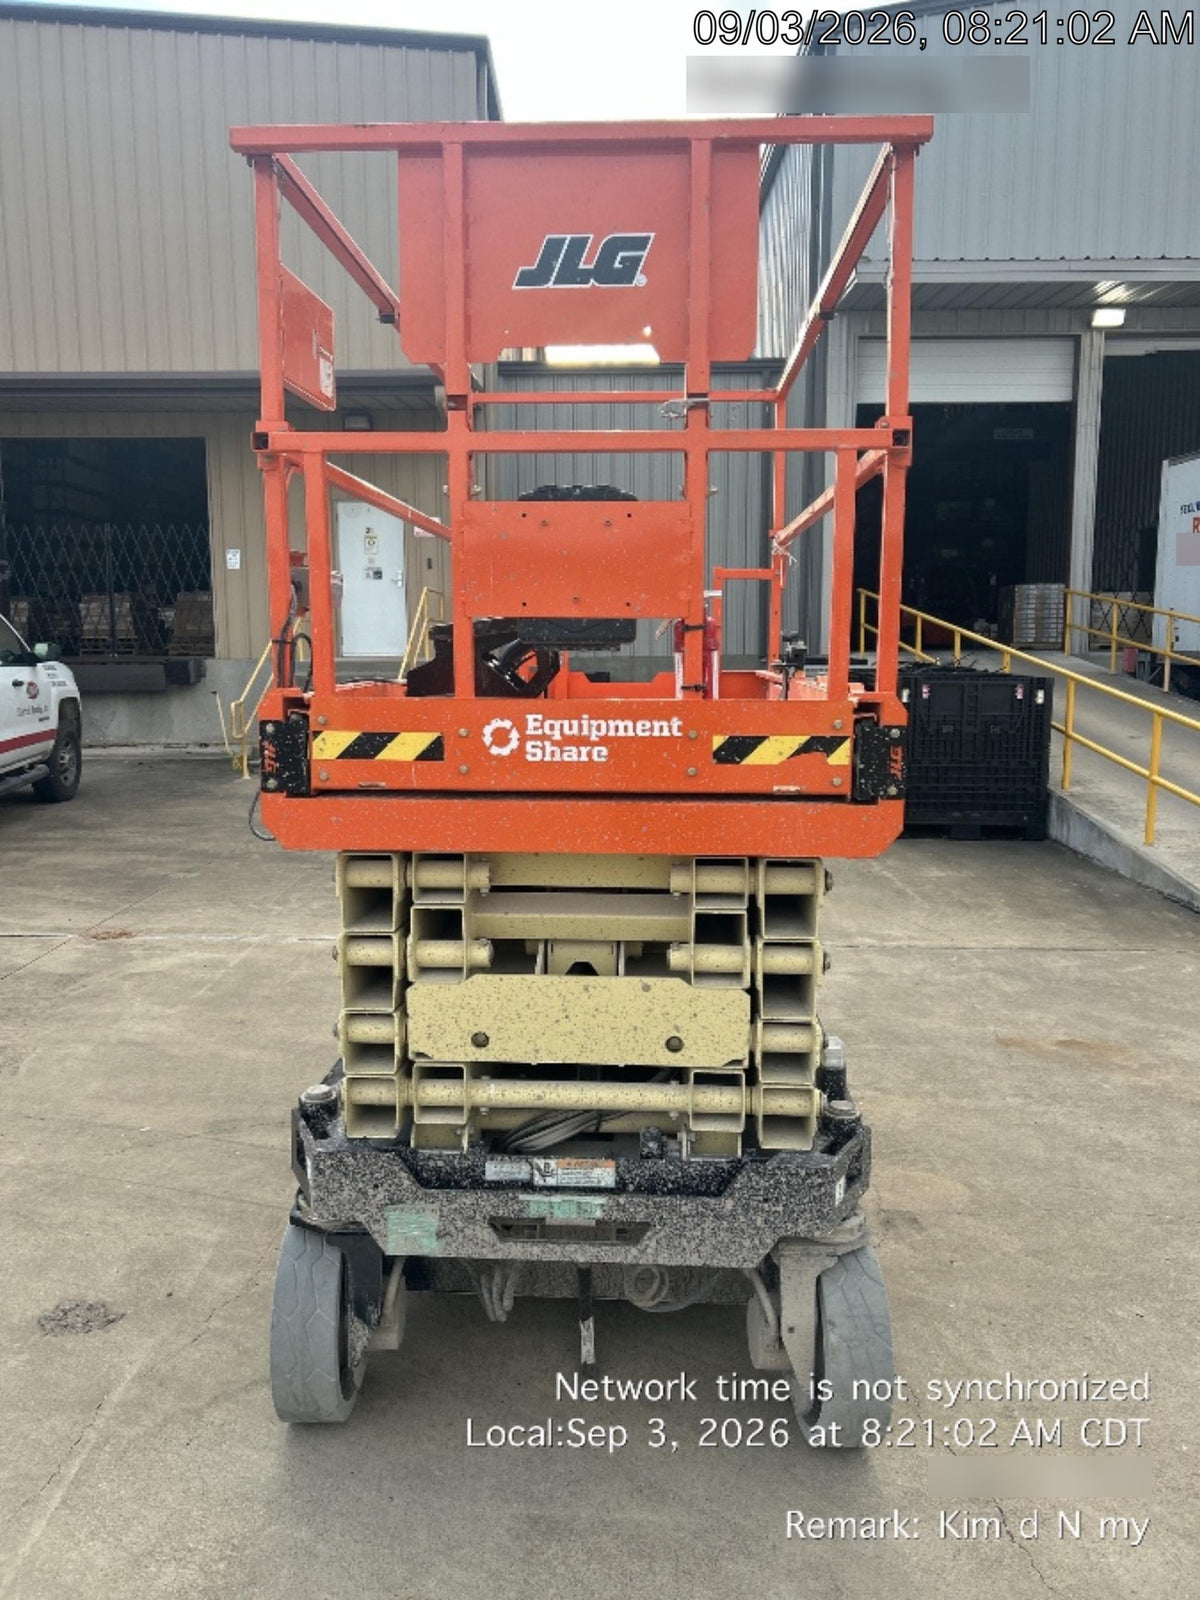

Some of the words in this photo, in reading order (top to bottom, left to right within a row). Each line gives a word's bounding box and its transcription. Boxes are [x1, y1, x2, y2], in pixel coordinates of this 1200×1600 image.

[512, 232, 656, 290] JLG
[525, 713, 683, 741] Equipment
[525, 740, 609, 762] Share
